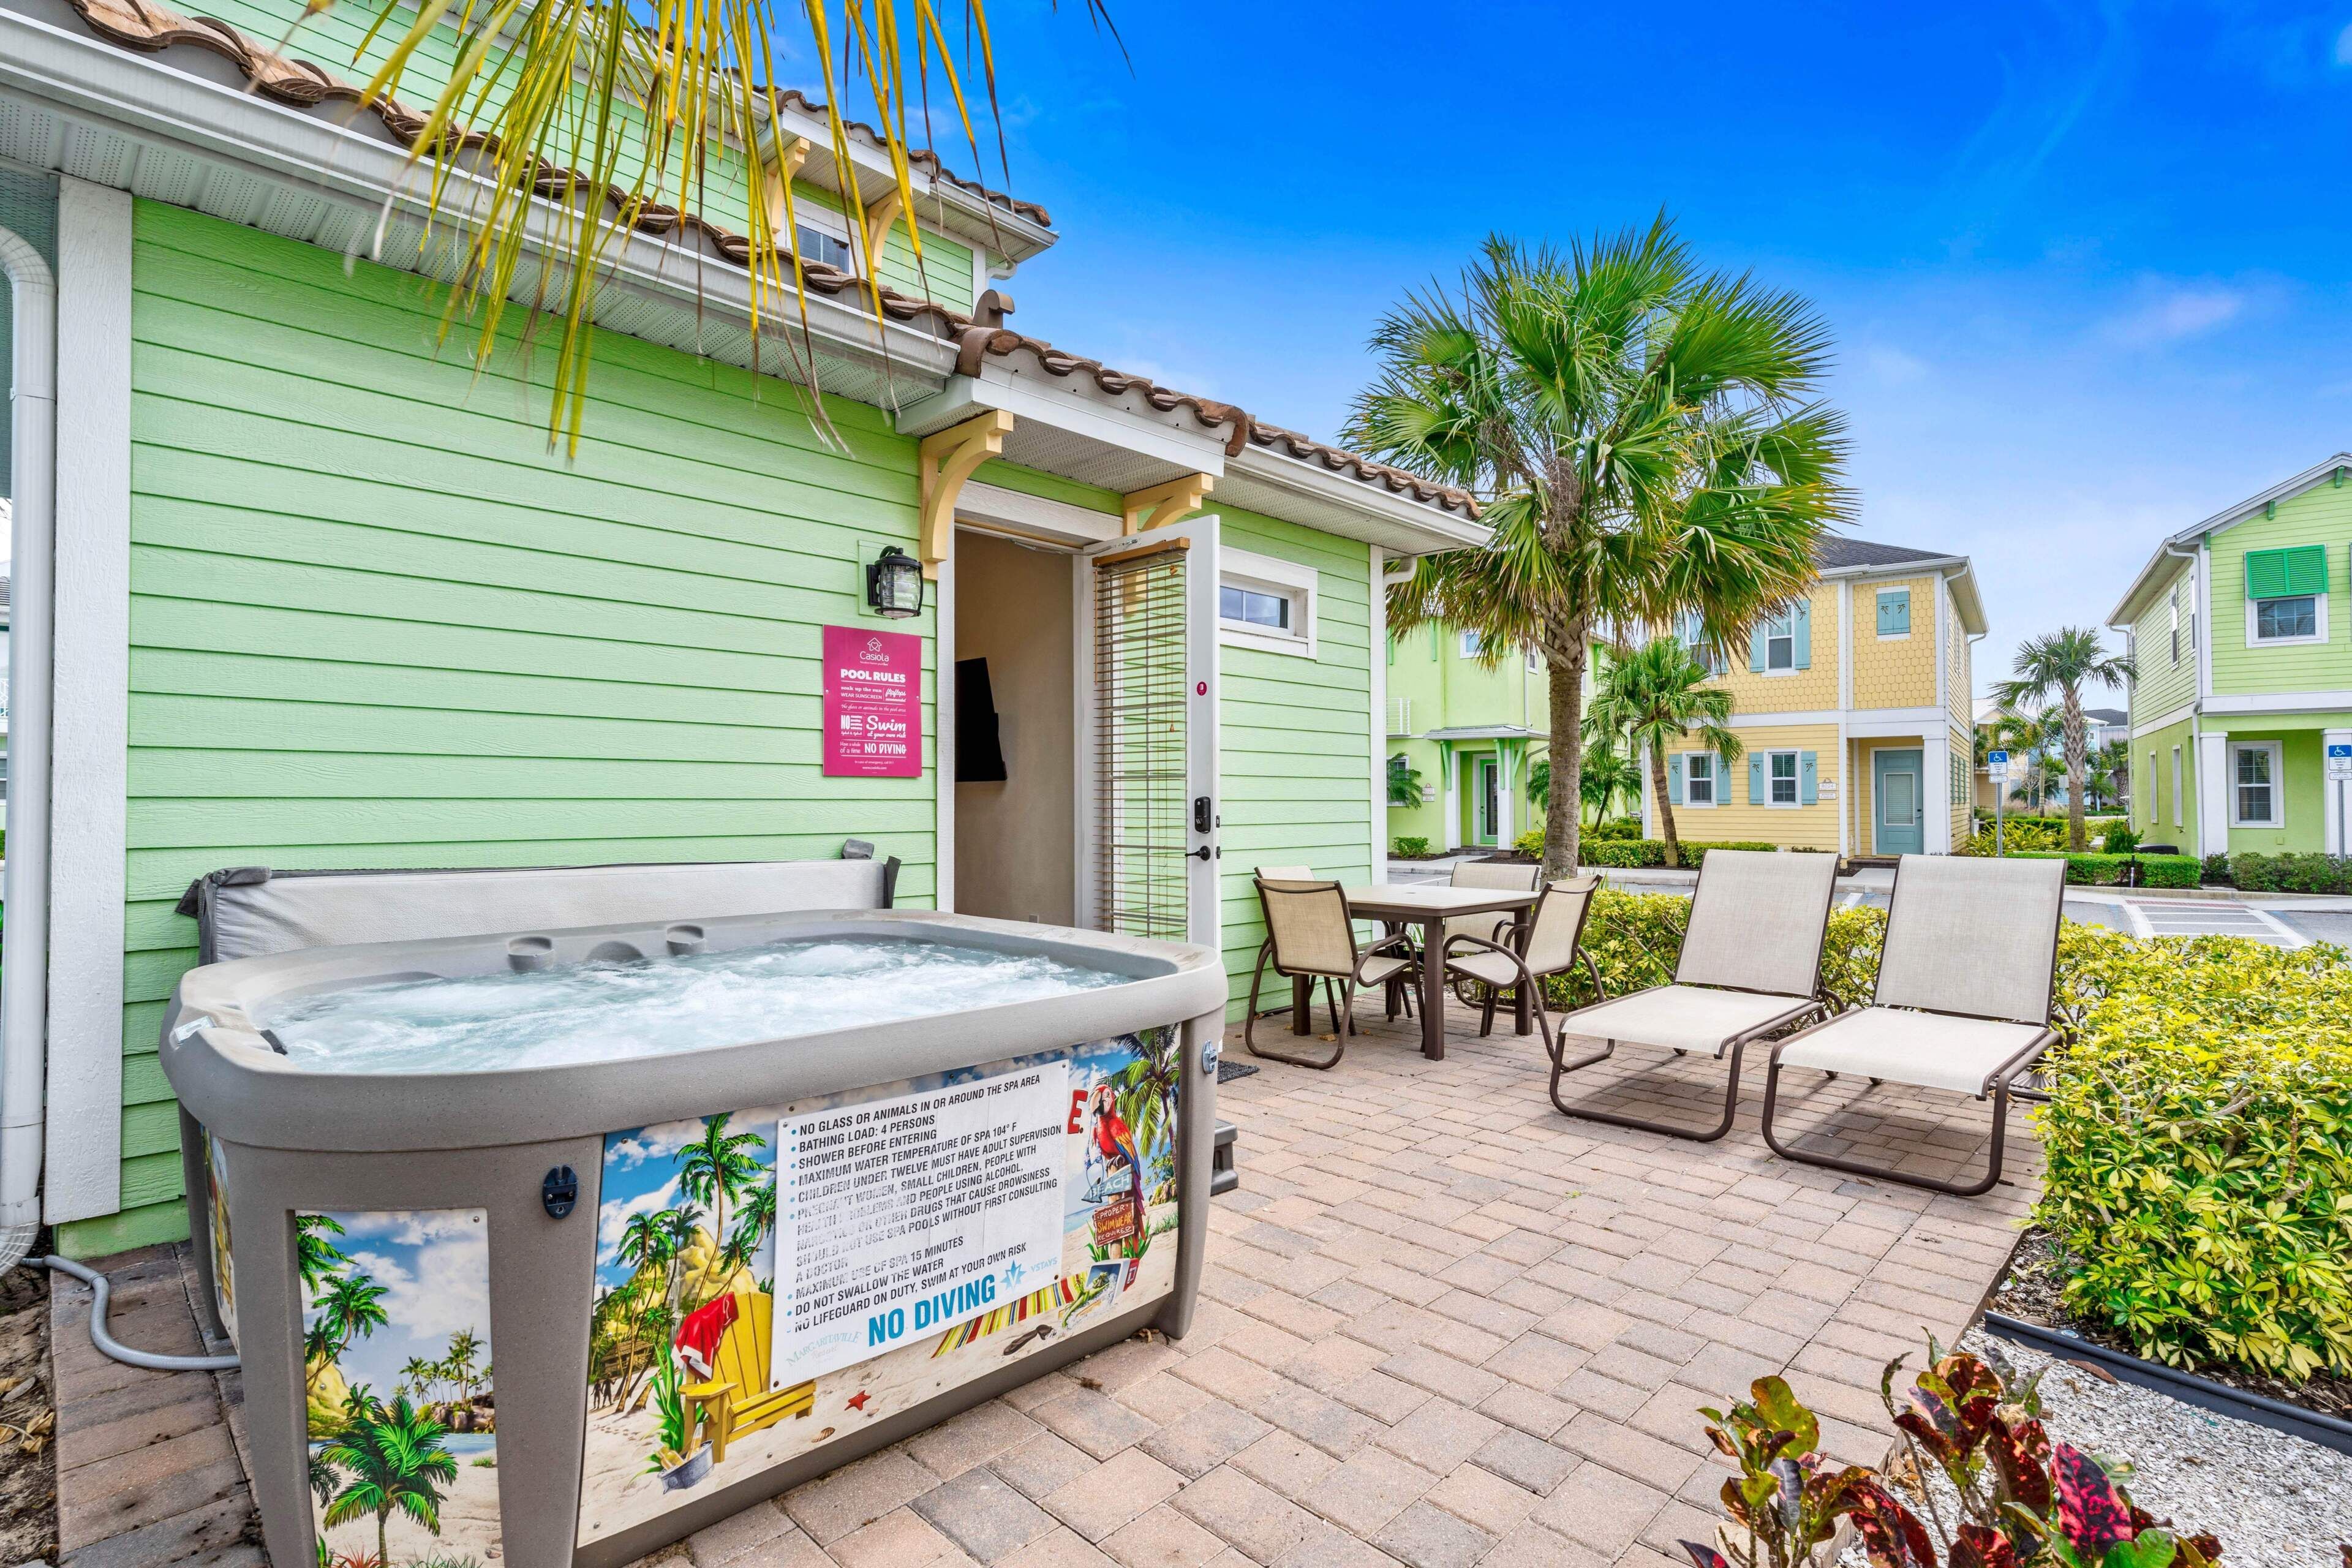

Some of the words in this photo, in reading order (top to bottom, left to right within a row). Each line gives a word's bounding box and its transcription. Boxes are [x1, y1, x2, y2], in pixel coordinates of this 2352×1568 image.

[859, 650, 889, 662] Casiola
[840, 668, 872, 680] POOL
[873, 671, 906, 683] RULES
[840, 715, 850, 729] NO
[865, 715, 907, 731] Swim
[864, 742, 877, 754] NO
[878, 743, 907, 755] DIVING
[801, 1123, 815, 1136] NO
[819, 1116, 852, 1132] GLASS
[856, 1113, 870, 1124] OR
[873, 1104, 917, 1121] ANIMALS
[921, 1101, 930, 1111] IN
[933, 1098, 946, 1109] OR
[948, 1089, 984, 1106] AROUND
[987, 1084, 1001, 1096] THE
[1004, 1080, 1018, 1091] SPA
[1020, 1075, 1039, 1087] AREA
[799, 1150, 844, 1169] SHOWER
[848, 1140, 886, 1158] BEFORE
[890, 1129, 937, 1148] ENTERING
[800, 1134, 844, 1152] BATHING
[848, 1127, 878, 1142] LOAD:
[881, 1125, 886, 1134] 4
[891, 1115, 935, 1133] PERSONS
[799, 1164, 851, 1186] MAXIMUM
[855, 1155, 888, 1171] WATER
[892, 1138, 958, 1163] TEMPERATURE
[961, 1134, 971, 1145] OF
[974, 1130, 990, 1142] SPA
[1012, 1122, 1016, 1131] F
[799, 1180, 850, 1202] CHILDREN
[854, 1171, 887, 1188] UNDER
[891, 1161, 927, 1178] TWELVE
[932, 1153, 956, 1169] MUST
[959, 1147, 979, 1161] HAVE
[982, 1139, 1008, 1155] ADULT
[1010, 1125, 1061, 1146] SUPERVISION
[902, 1176, 933, 1190] SMALL
[937, 1162, 981, 1182] CHILDREN,
[986, 1152, 1014, 1169] PEOPLE
[1017, 1145, 1036, 1158] WITH
[911, 1200, 942, 1218] DRUGS
[946, 1193, 966, 1207] THAT
[969, 1184, 996, 1200] CAUSE
[999, 1167, 1049, 1191] DROWSINESS
[920, 1183, 952, 1201] PEOPLE
[956, 1175, 982, 1190] USING
[986, 1163, 1023, 1182] ALCOHOL,
[888, 1225, 905, 1238] SPA
[909, 1216, 939, 1232] POOLS
[943, 1202, 981, 1222] WITHOUT
[986, 1194, 1006, 1209] FIRST
[1009, 1178, 1057, 1200] CONSULTING
[1097, 1213, 1132, 1234] SWIMWEAR
[1100, 1205, 1125, 1219] PROPER
[1098, 1226, 1132, 1240] REQUIRED
[875, 1261, 886, 1273] OF
[890, 1256, 907, 1268] SPA
[911, 1251, 921, 1261] 15
[925, 1236, 963, 1258] MINUTES
[1030, 1256, 1057, 1273] VSTAYS
[796, 1270, 803, 1283] A
[796, 1319, 809, 1332] NO
[814, 1298, 870, 1326] LIFEGUARD
[874, 1292, 887, 1305] ON
[891, 1283, 917, 1299] DUTY,
[922, 1272, 946, 1289] SWIM
[949, 1267, 959, 1279] AT
[962, 1259, 984, 1274] YOUR
[988, 1250, 1005, 1265] OWN
[1009, 1242, 1026, 1257] RISK
[796, 1302, 810, 1316] DO
[814, 1294, 834, 1309] NOT
[838, 1276, 888, 1301] SWALLOW
[892, 1269, 909, 1283] THE
[913, 1259, 943, 1276] WATER
[868, 1308, 905, 1346] NO
[914, 1275, 995, 1330] DIVING
[786, 1330, 862, 1366] MARGARITAVILLE
